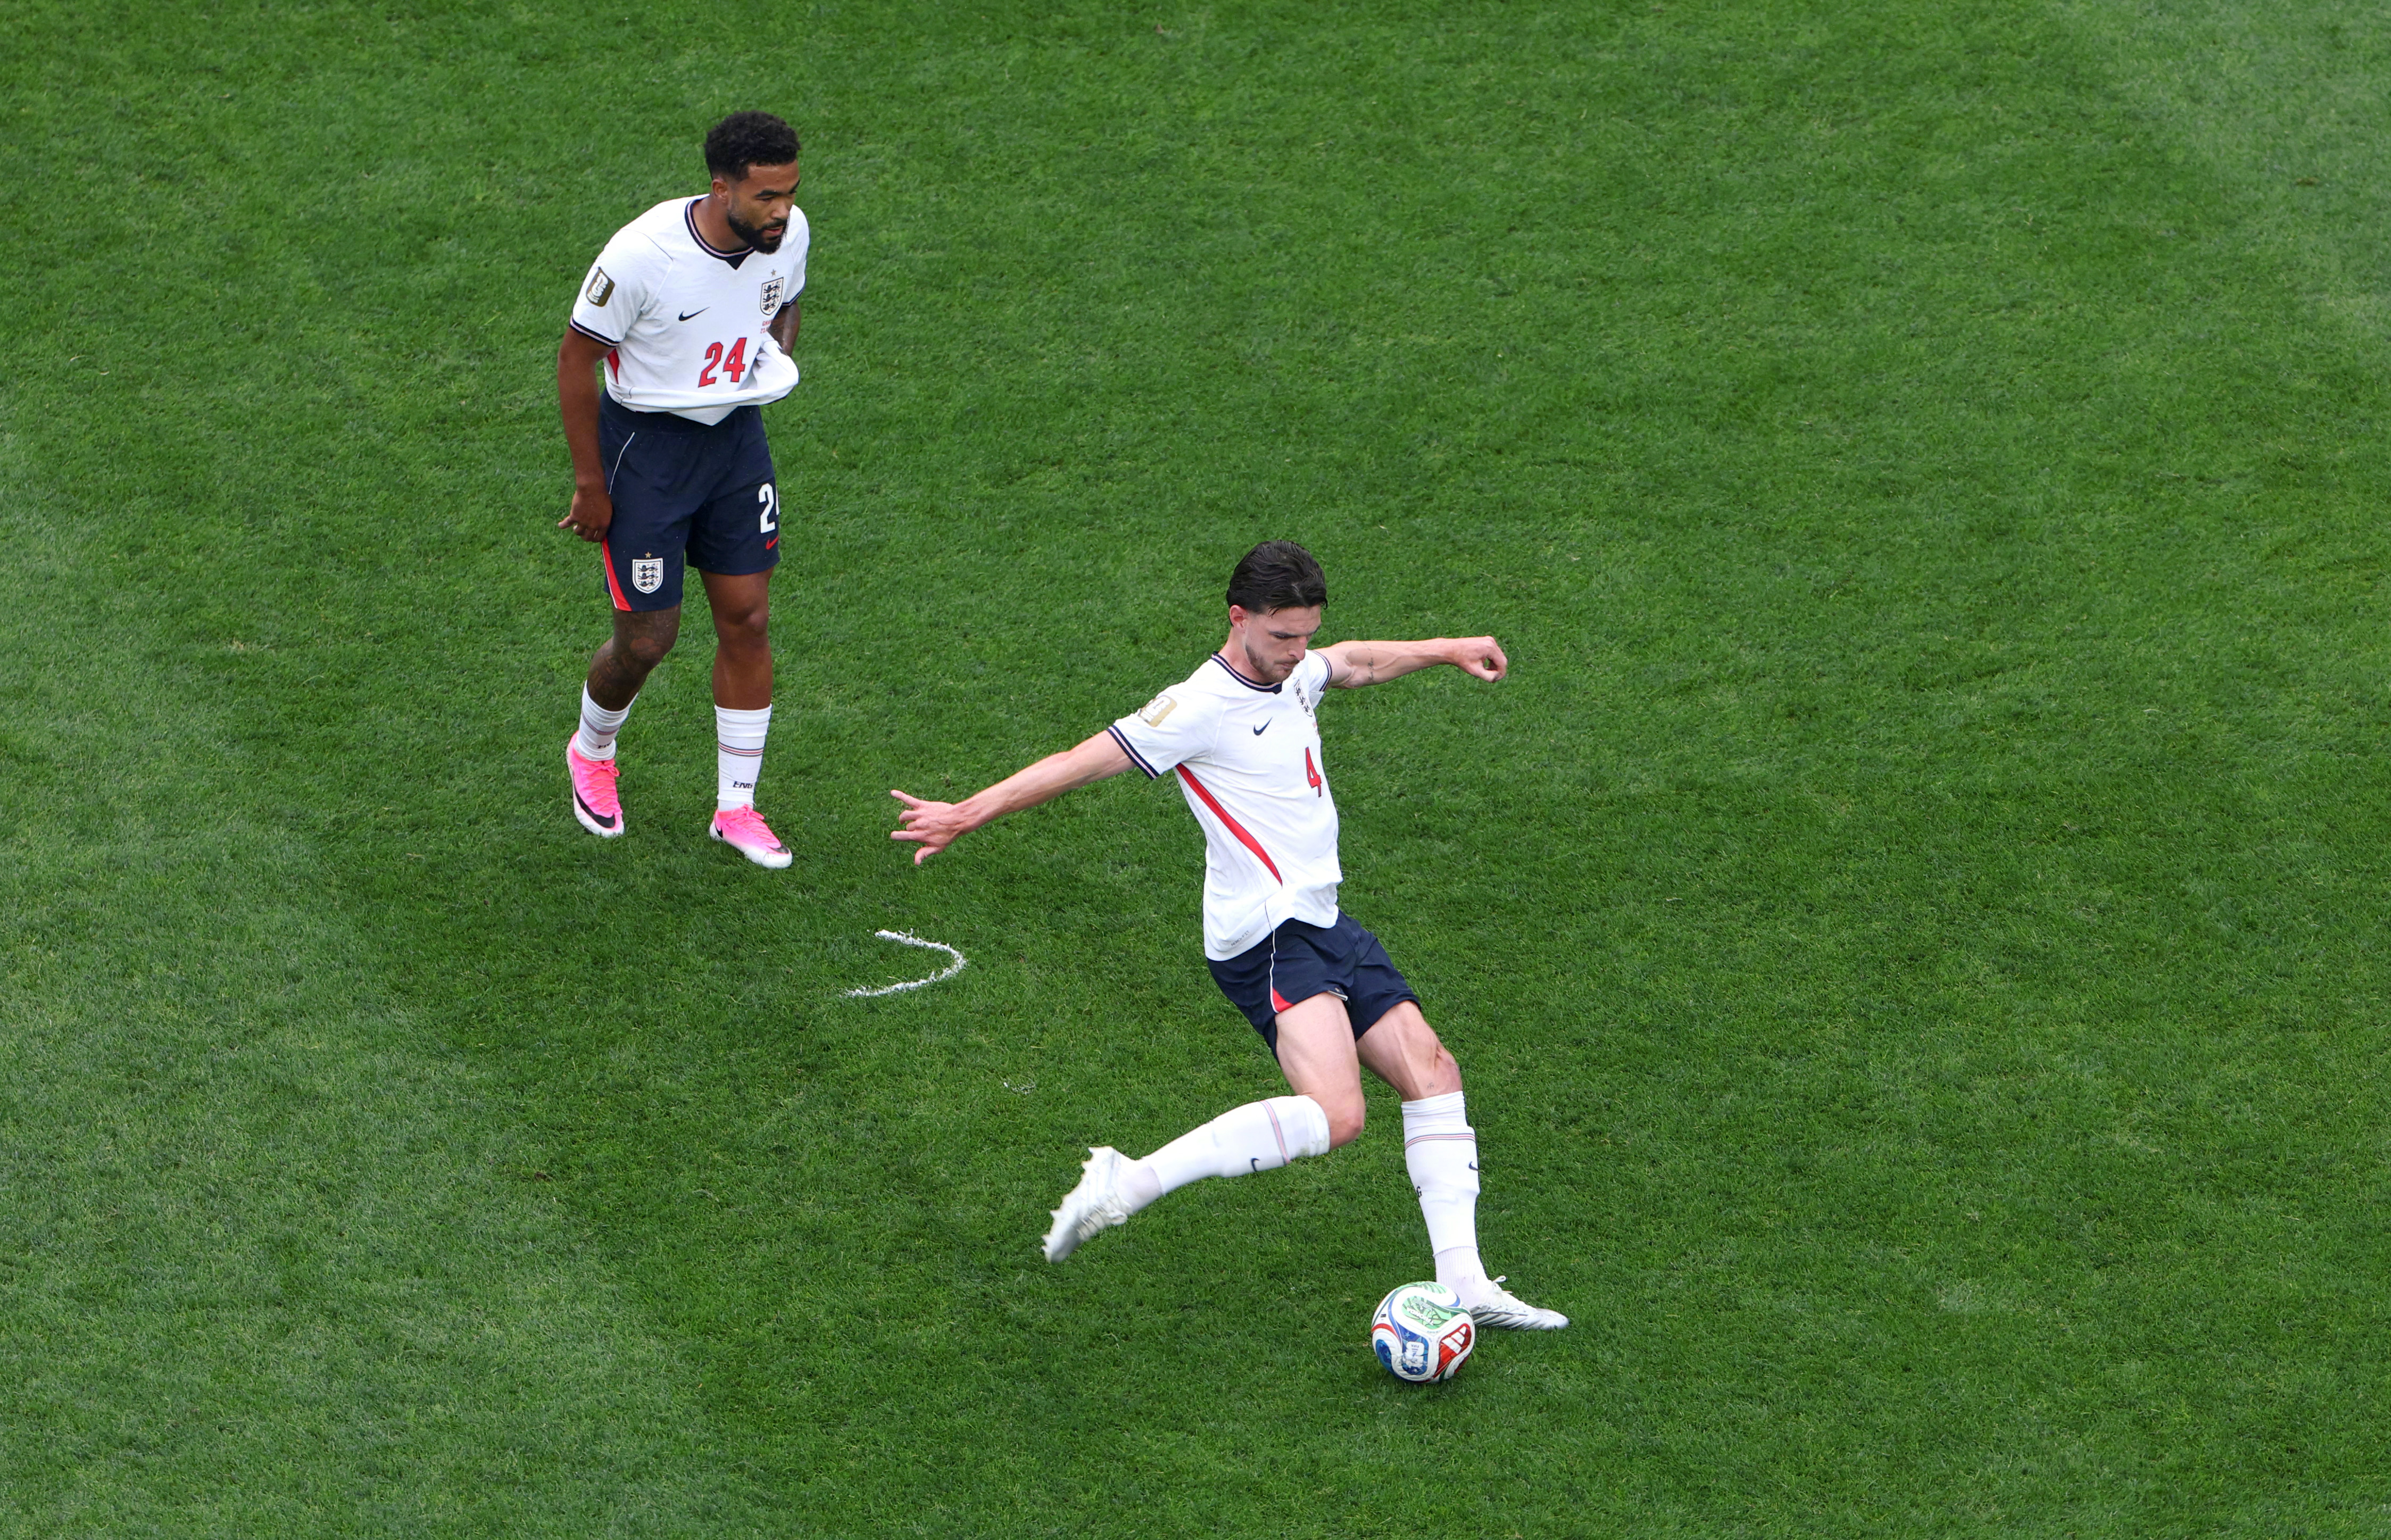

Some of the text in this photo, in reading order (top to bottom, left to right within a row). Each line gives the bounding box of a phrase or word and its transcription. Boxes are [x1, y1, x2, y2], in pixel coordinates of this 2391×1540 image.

[698, 337, 747, 387] 24
[758, 482, 779, 534] 2
[1305, 746, 1322, 797] 4
